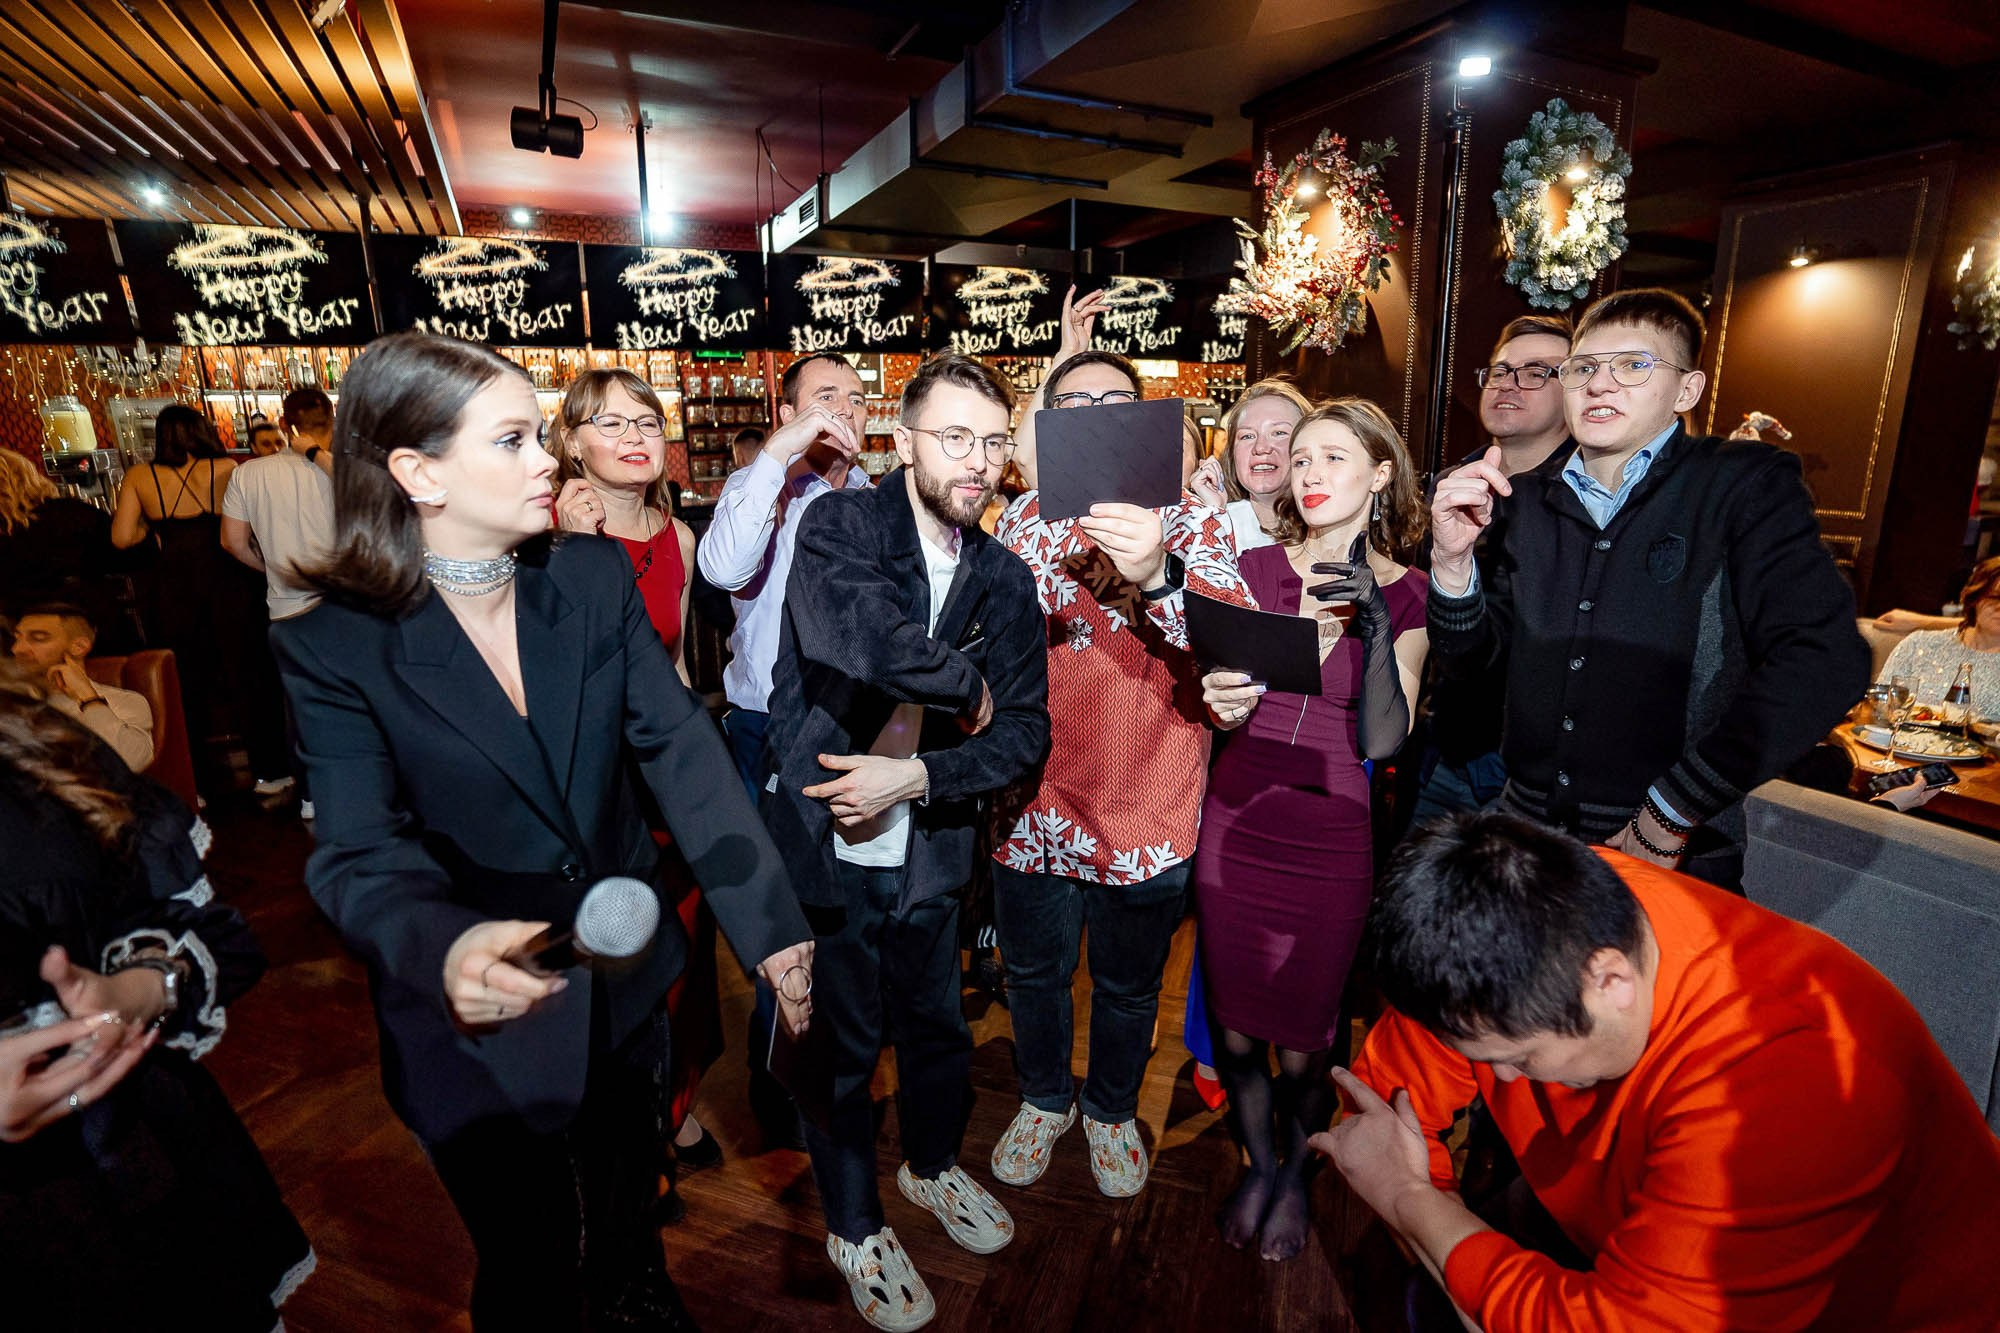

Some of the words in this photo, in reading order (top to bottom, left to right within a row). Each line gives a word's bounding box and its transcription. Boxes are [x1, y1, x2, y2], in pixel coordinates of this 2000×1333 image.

[200, 270, 303, 312] Happy
[437, 278, 526, 315] Happy
[639, 285, 717, 320] Happy
[811, 292, 882, 324] Happy
[3, 291, 108, 334] Year
[174, 311, 265, 346] New
[269, 298, 359, 338] Year
[496, 303, 572, 339] Year
[616, 320, 683, 350] New
[688, 308, 756, 342] Year
[969, 300, 1031, 329] Happy
[1103, 307, 1158, 335] Happy
[790, 324, 850, 352] New
[855, 315, 914, 345] Year
[950, 329, 1003, 355] New
[1007, 320, 1060, 349] Year
[1134, 326, 1182, 353] Year
[1202, 340, 1245, 363] New
